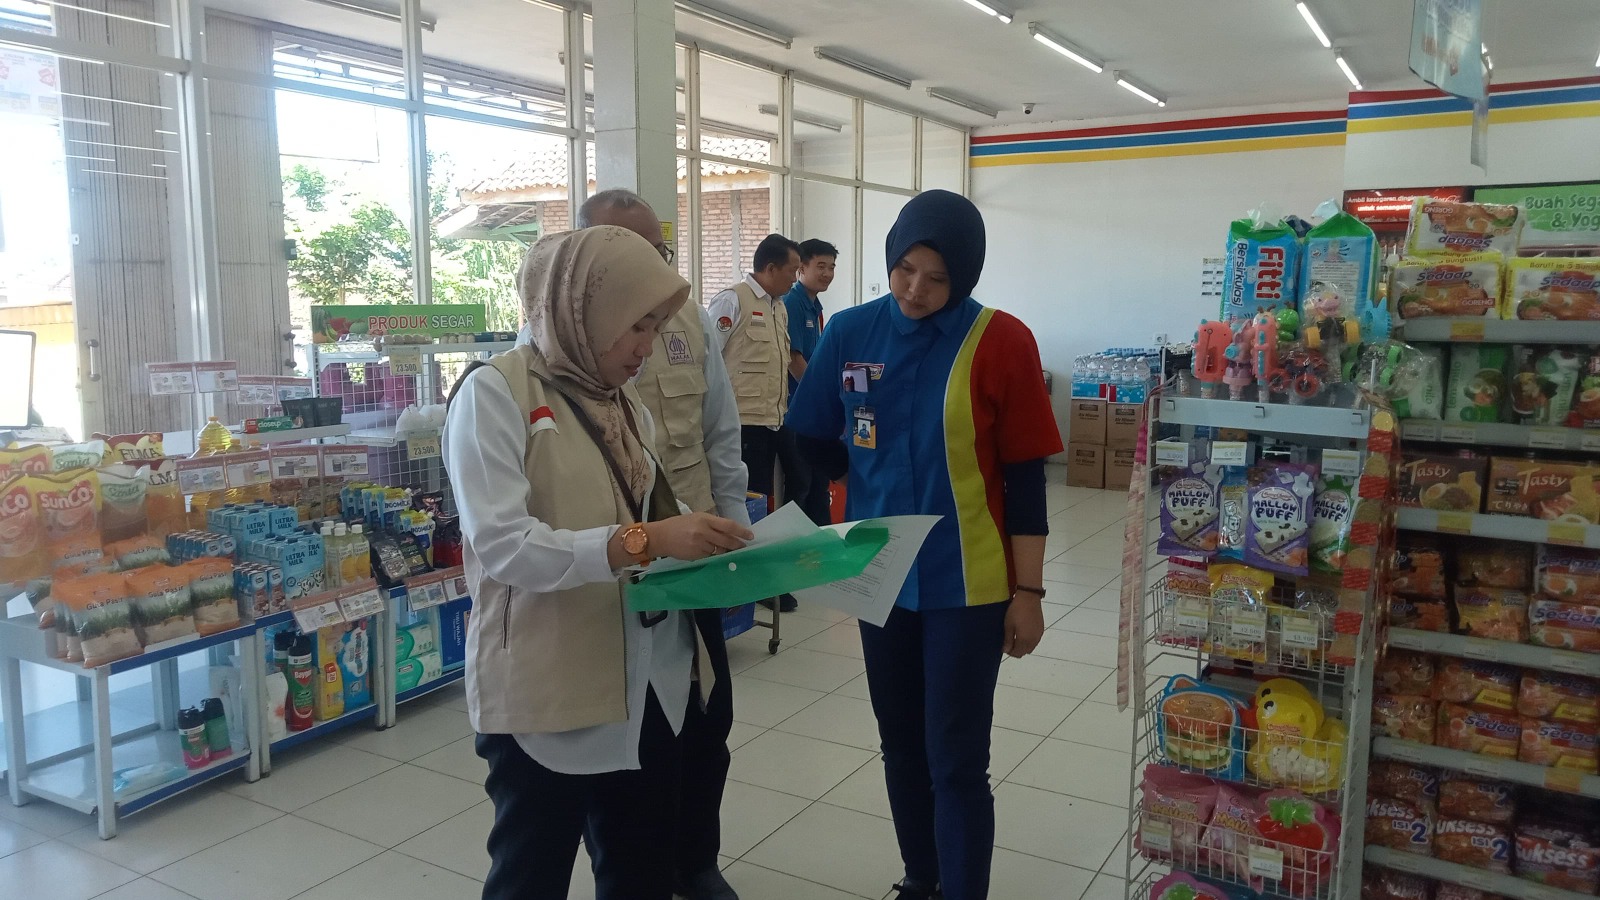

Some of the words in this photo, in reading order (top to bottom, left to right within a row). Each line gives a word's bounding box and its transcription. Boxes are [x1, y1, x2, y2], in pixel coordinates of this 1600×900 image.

[1525, 195, 1564, 209] Buah
[1424, 206, 1454, 214] GORENG
[1552, 213, 1567, 228] &
[1438, 235, 1492, 250] Sedaap
[1256, 246, 1284, 299] Fitti
[1417, 270, 1472, 282] Sedaap
[1540, 276, 1600, 289] Sedaap
[368, 316, 428, 330] PRODUK
[432, 314, 474, 328] SEGAR
[120, 448, 162, 460] FILMA
[1405, 458, 1451, 486] Tasty
[1517, 468, 1568, 494] Tasty
[1168, 490, 1210, 498] MALLOW
[1172, 498, 1206, 508] PUFF
[1254, 500, 1298, 513] MALLOW
[275, 516, 294, 524] ULTRA
[1256, 509, 1294, 521] PUFF
[1314, 509, 1342, 522] PUFF
[246, 522, 266, 530] ULTRA
[278, 522, 292, 530] MILK
[286, 552, 305, 562] ULTRA
[288, 558, 304, 566] MILK
[165, 586, 184, 595] Pasir
[1540, 725, 1600, 744] Sedaa
[1423, 777, 1437, 796] 2
[1366, 799, 1415, 819] ksess
[1392, 820, 1410, 830] ISI
[1410, 822, 1428, 843] 2
[1436, 818, 1496, 836] uksess
[1472, 836, 1489, 848] ISI
[1491, 839, 1508, 860] 2
